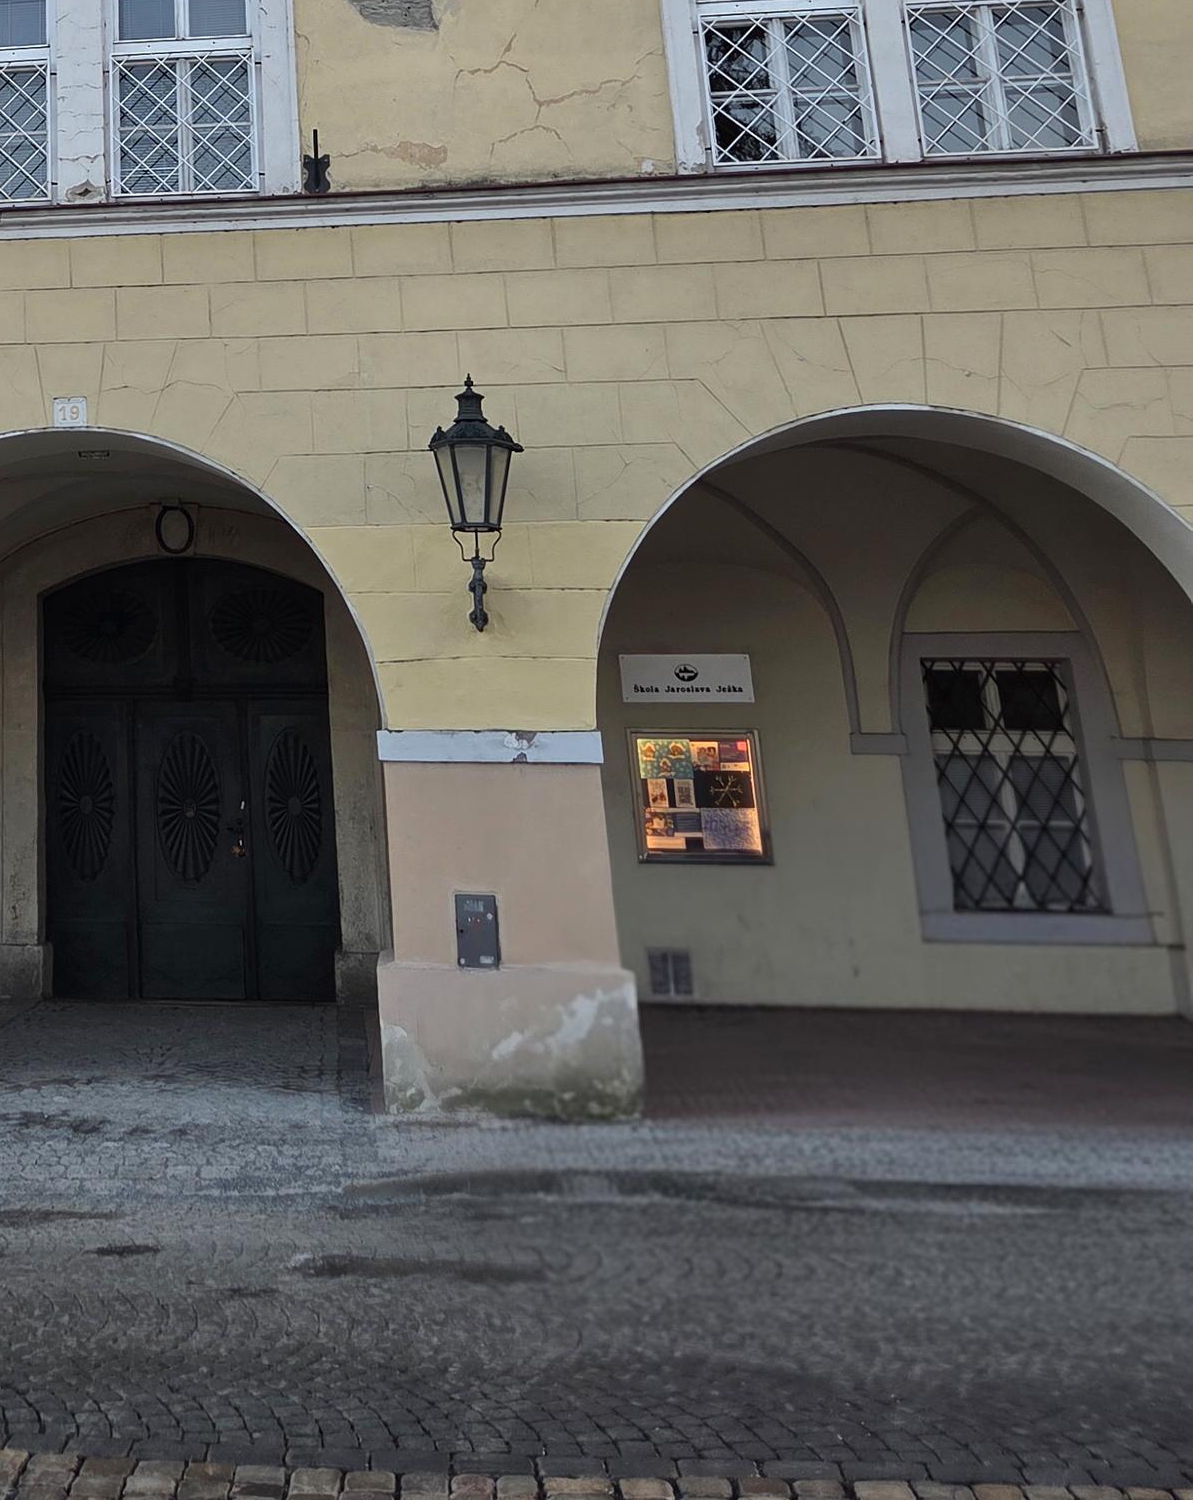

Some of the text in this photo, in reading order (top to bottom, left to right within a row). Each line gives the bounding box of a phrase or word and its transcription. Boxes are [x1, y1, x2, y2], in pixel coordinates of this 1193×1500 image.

[58, 405, 80, 421] 19
[633, 684, 660, 693] Škola
[665, 685, 711, 693] Jaroslava
